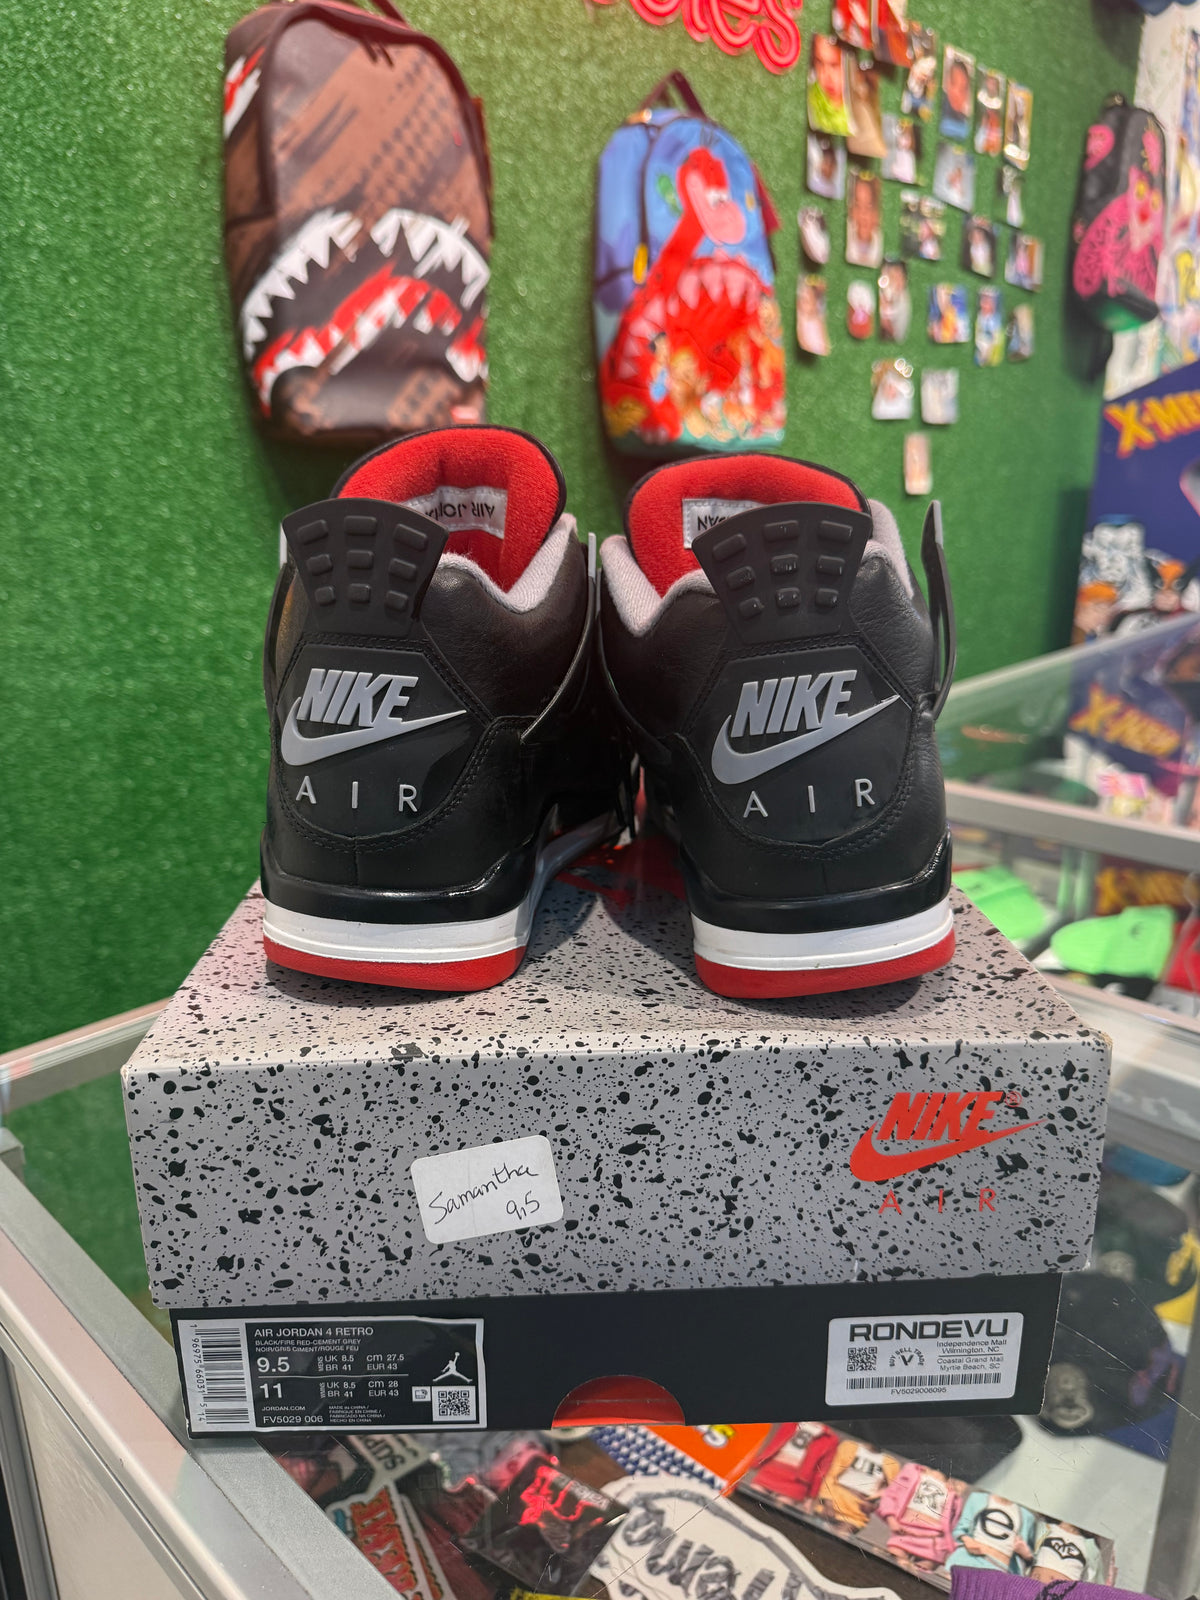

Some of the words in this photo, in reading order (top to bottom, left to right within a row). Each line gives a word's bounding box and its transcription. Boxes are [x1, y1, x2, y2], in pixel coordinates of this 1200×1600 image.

[471, 501, 495, 520] AIR
[296, 668, 418, 728] NIKE
[730, 669, 858, 738] NIKE
[428, 1162, 540, 1225] Samantha
[254, 1329, 273, 1337] AIR
[276, 1328, 323, 1337] JORDAN
[325, 1327, 333, 1336] 4
[335, 1326, 374, 1336] RETRO
[849, 1318, 1009, 1342] RONDEVU
[936, 1340, 989, 1348] Independence
[990, 1338, 1007, 1346] Mall
[191, 1338, 203, 1365] 96975
[341, 1354, 355, 1362] 8.5
[366, 1354, 383, 1362] cm
[386, 1353, 405, 1361] 27.5
[256, 1356, 291, 1373] 9.5
[367, 1363, 385, 1371] EUR
[936, 1356, 964, 1365] Coastal
[965, 1356, 987, 1364] Grand
[989, 1362, 1001, 1370] SC
[195, 1368, 206, 1394] 66031
[343, 1381, 356, 1389] 8.5
[368, 1380, 385, 1388] cm
[388, 1380, 399, 1388] 28
[260, 1383, 283, 1399] 11
[327, 1390, 340, 1398] BR
[388, 1389, 399, 1397] 43
[263, 1416, 301, 1424] FV5029
[304, 1415, 324, 1423] 006
